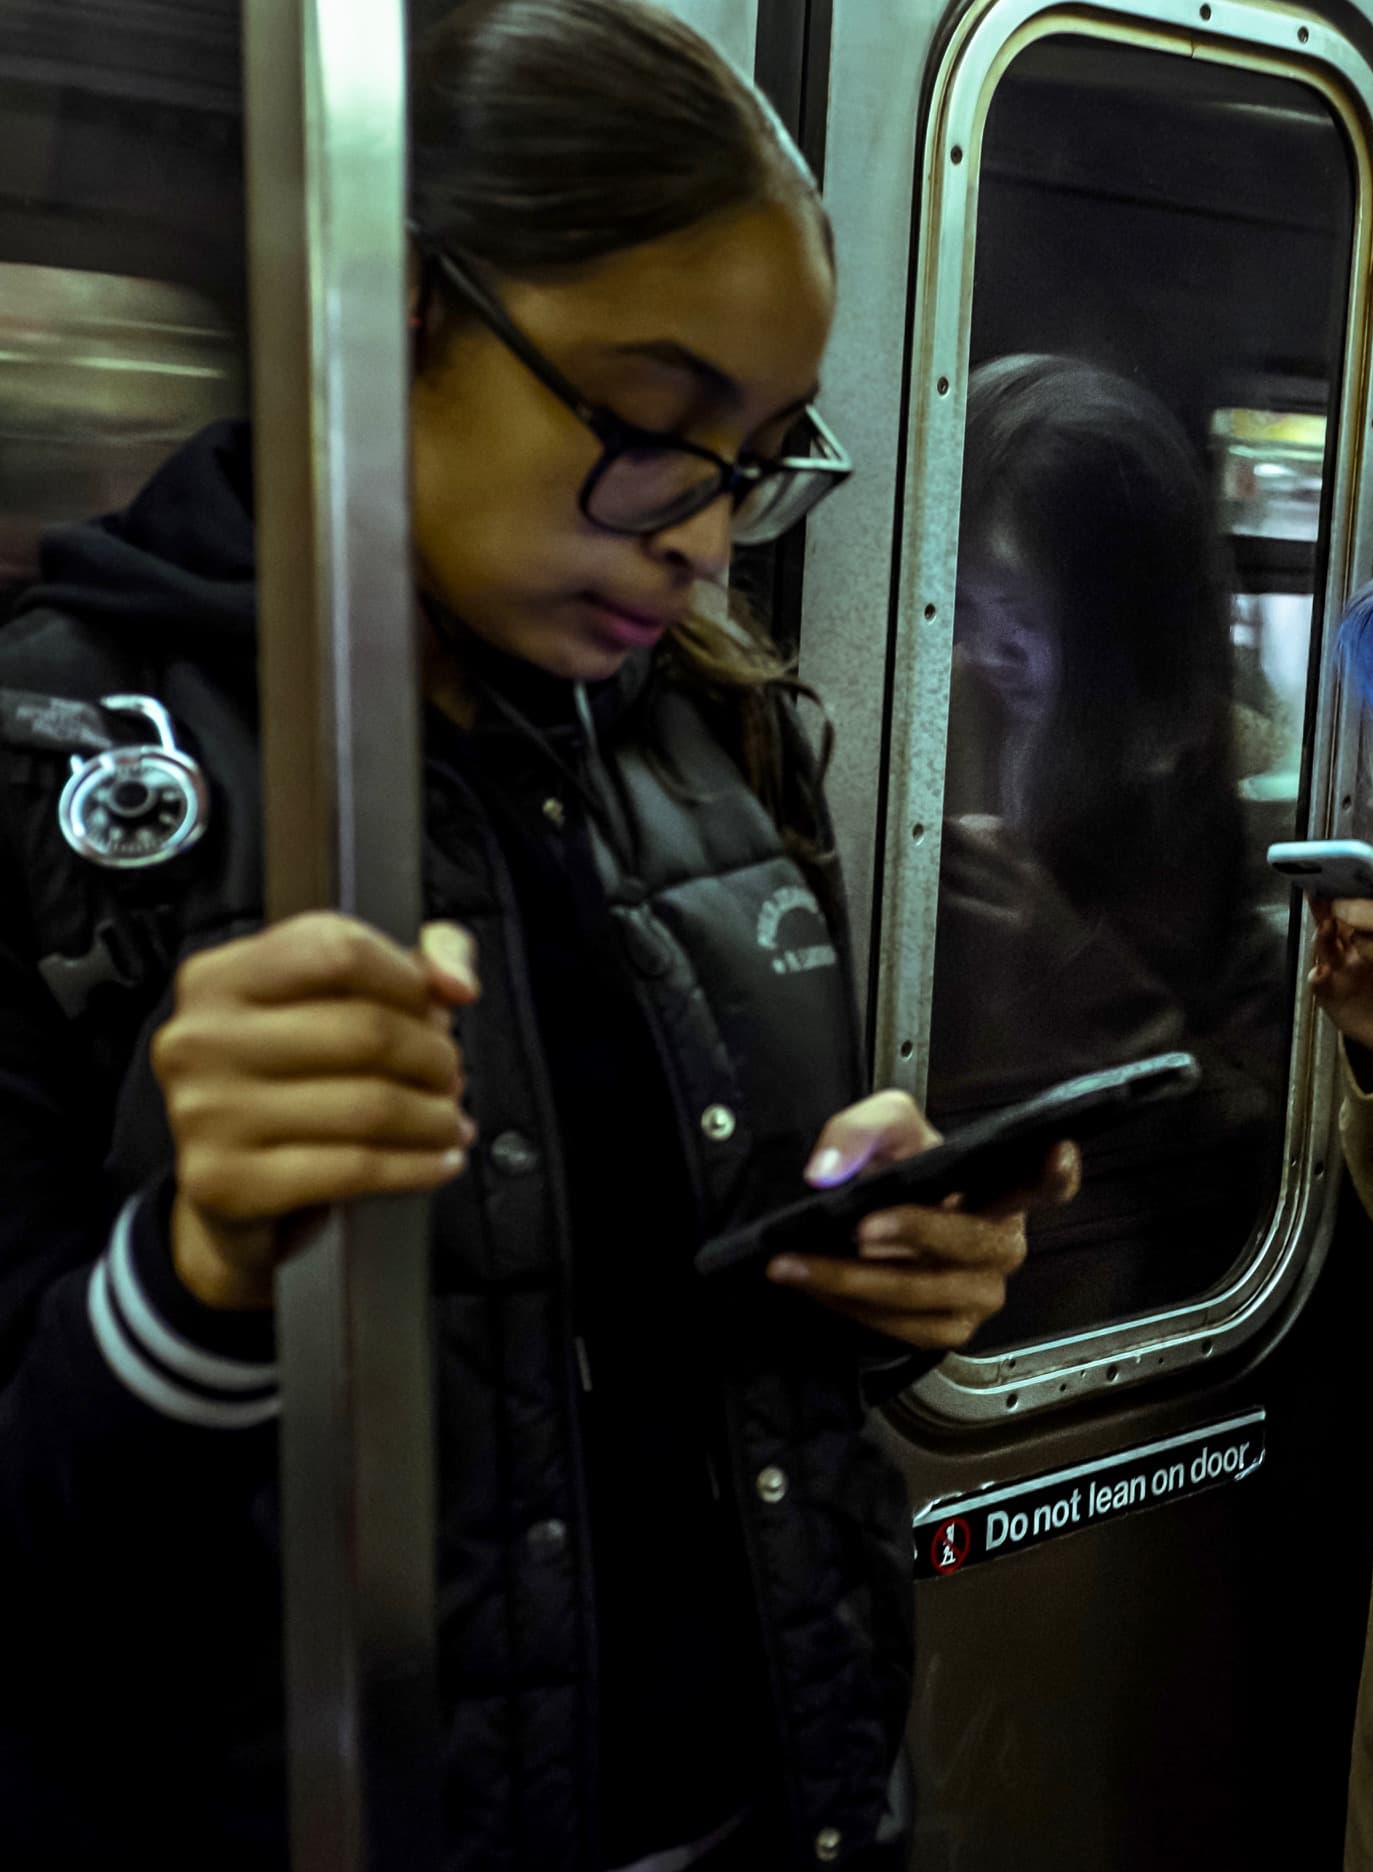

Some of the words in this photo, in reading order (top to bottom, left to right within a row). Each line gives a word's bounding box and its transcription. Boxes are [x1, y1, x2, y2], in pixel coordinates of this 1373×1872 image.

[986, 1510, 1028, 1551] Do
[1033, 1489, 1081, 1535] not
[1088, 1474, 1146, 1518] lean
[1151, 1463, 1184, 1495] on
[1190, 1441, 1250, 1484] door
